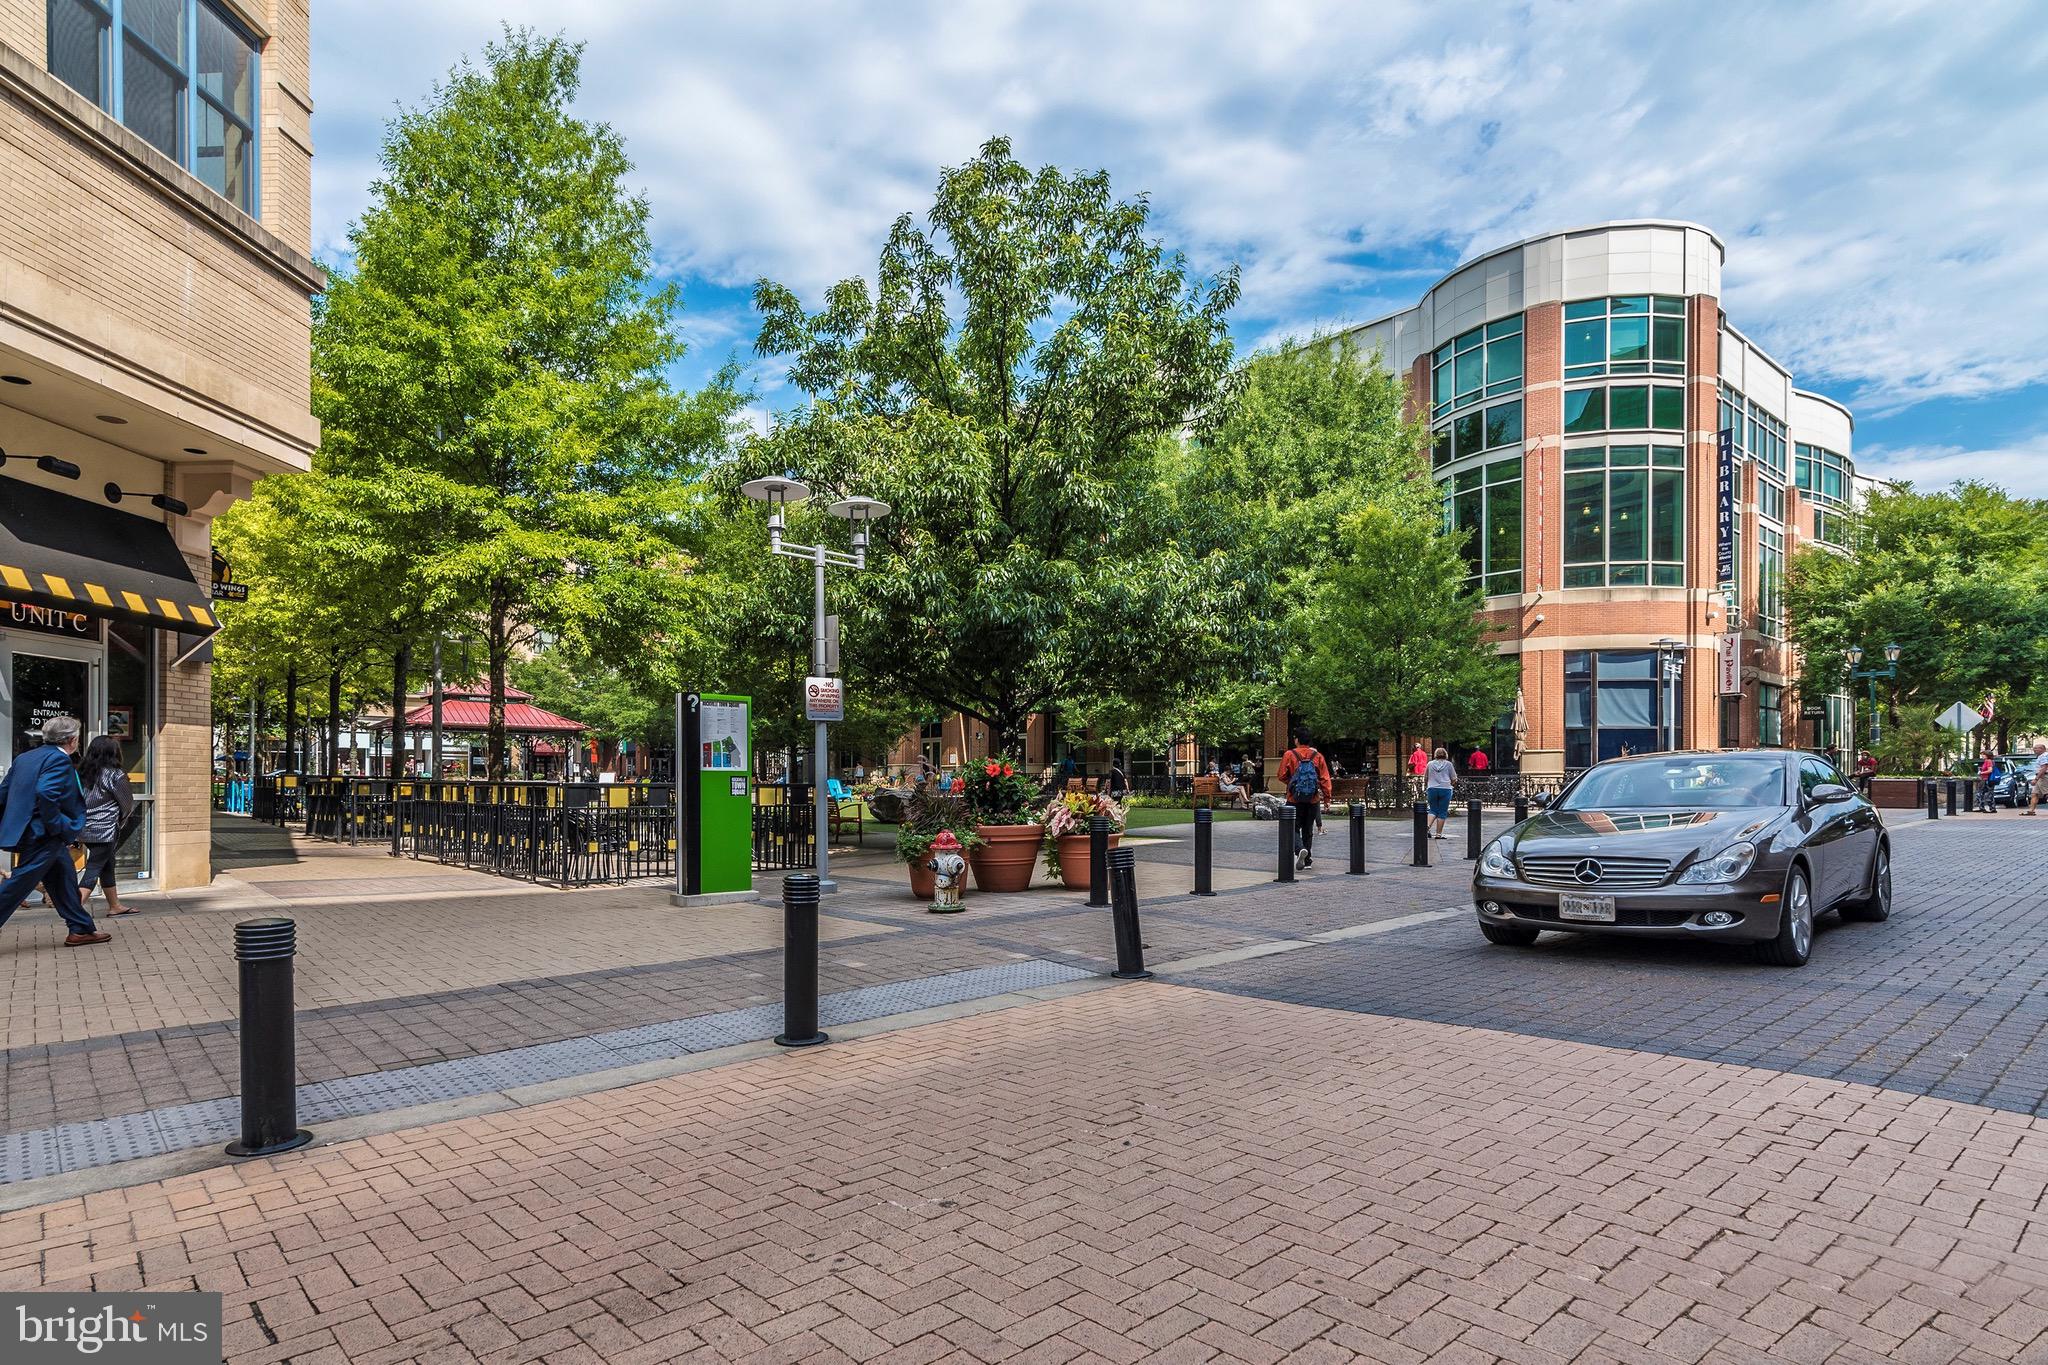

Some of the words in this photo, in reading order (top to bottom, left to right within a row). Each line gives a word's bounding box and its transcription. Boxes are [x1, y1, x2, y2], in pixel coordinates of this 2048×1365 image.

[1719, 435, 1730, 538] LIBRARY
[220, 583, 246, 592] WINGS
[10, 602, 68, 629] UNIT
[73, 614, 88, 632] C
[42, 700, 60, 708] MAIN
[33, 709, 69, 717] ENTRANCE
[30, 717, 41, 726] TO
